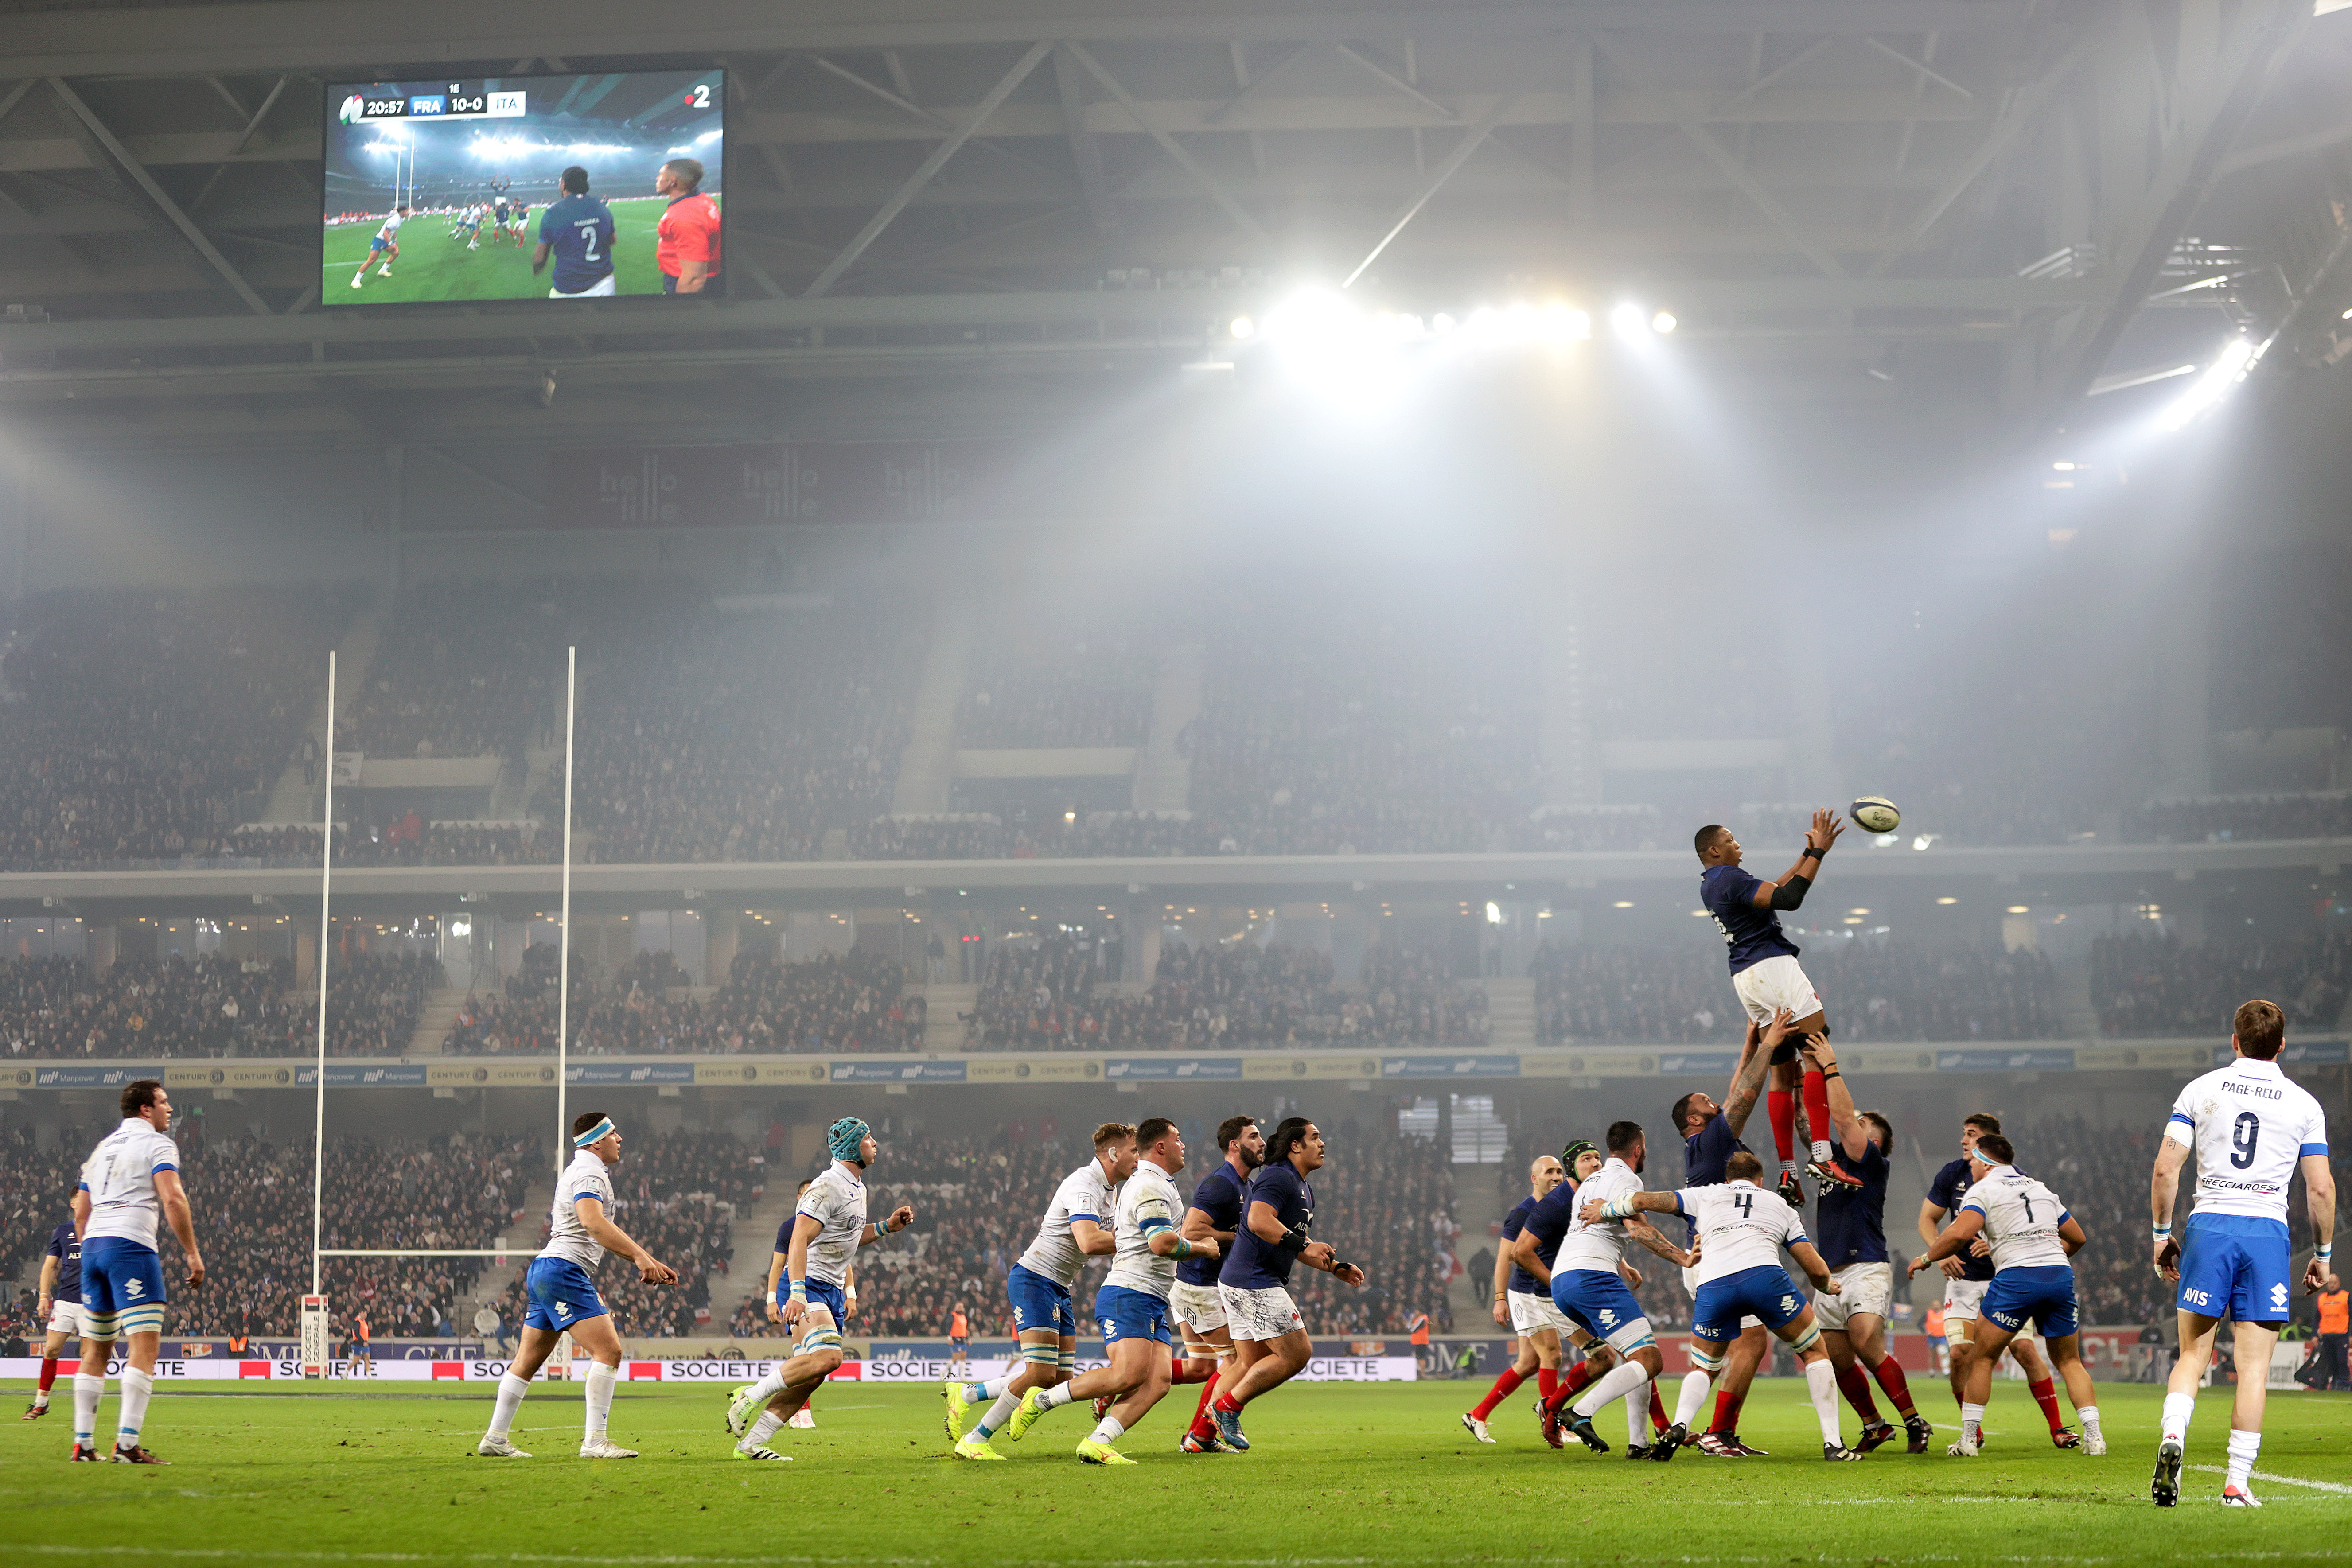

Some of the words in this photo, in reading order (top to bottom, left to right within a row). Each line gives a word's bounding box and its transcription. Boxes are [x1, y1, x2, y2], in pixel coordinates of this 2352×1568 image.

[367, 100, 405, 115] 20:57
[413, 100, 441, 114] FRA
[451, 97, 483, 112] 10-0
[497, 97, 518, 109] ITA
[581, 226, 600, 261] 2
[60, 1074, 96, 1082] Manpower
[2221, 1082, 2282, 1100] PAGE-RELO
[2230, 1112, 2259, 1170] 9
[101, 1154, 118, 1195] 7
[1735, 1193, 1753, 1219] 4
[2020, 1192, 2035, 1224] 1
[2183, 1288, 2209, 1306] AVIS
[1992, 1311, 2021, 1327] AVIS
[671, 1362, 771, 1377] SOCIETE
